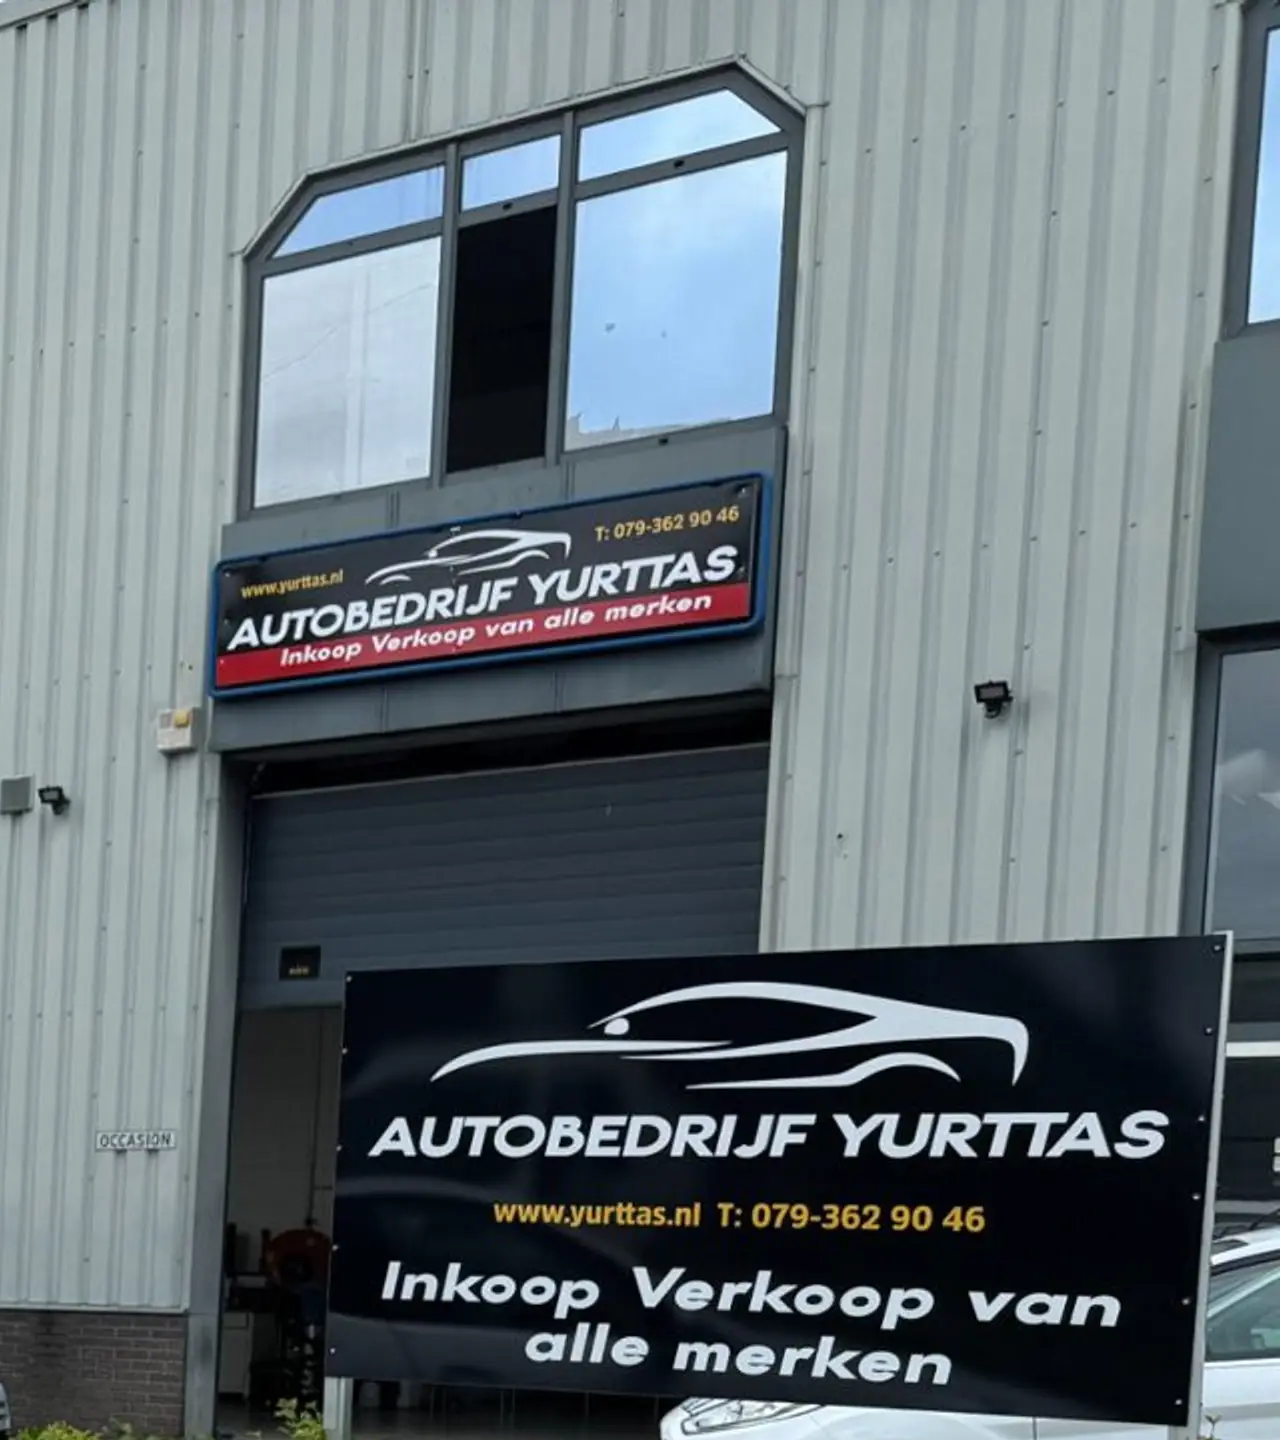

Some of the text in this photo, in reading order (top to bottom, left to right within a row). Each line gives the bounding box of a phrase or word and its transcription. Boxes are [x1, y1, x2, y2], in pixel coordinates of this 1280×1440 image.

[596, 504, 739, 541] T: 079-362 90 46
[227, 545, 738, 651] AUTOBEDRIJF YURTTAS
[241, 569, 344, 599] www.yurttas.nl
[280, 595, 712, 667] Inkoop Verkoop van alle merken
[100, 1132, 172, 1148] OCCASION
[368, 1109, 1170, 1159] AUTOBEDRIJF YURTTAS
[494, 1202, 985, 1232] www.yurttas.nl T: 079-362 90 46
[381, 1261, 1121, 1330] Inkoop Verkoop van
[524, 1322, 952, 1385] alle merken
